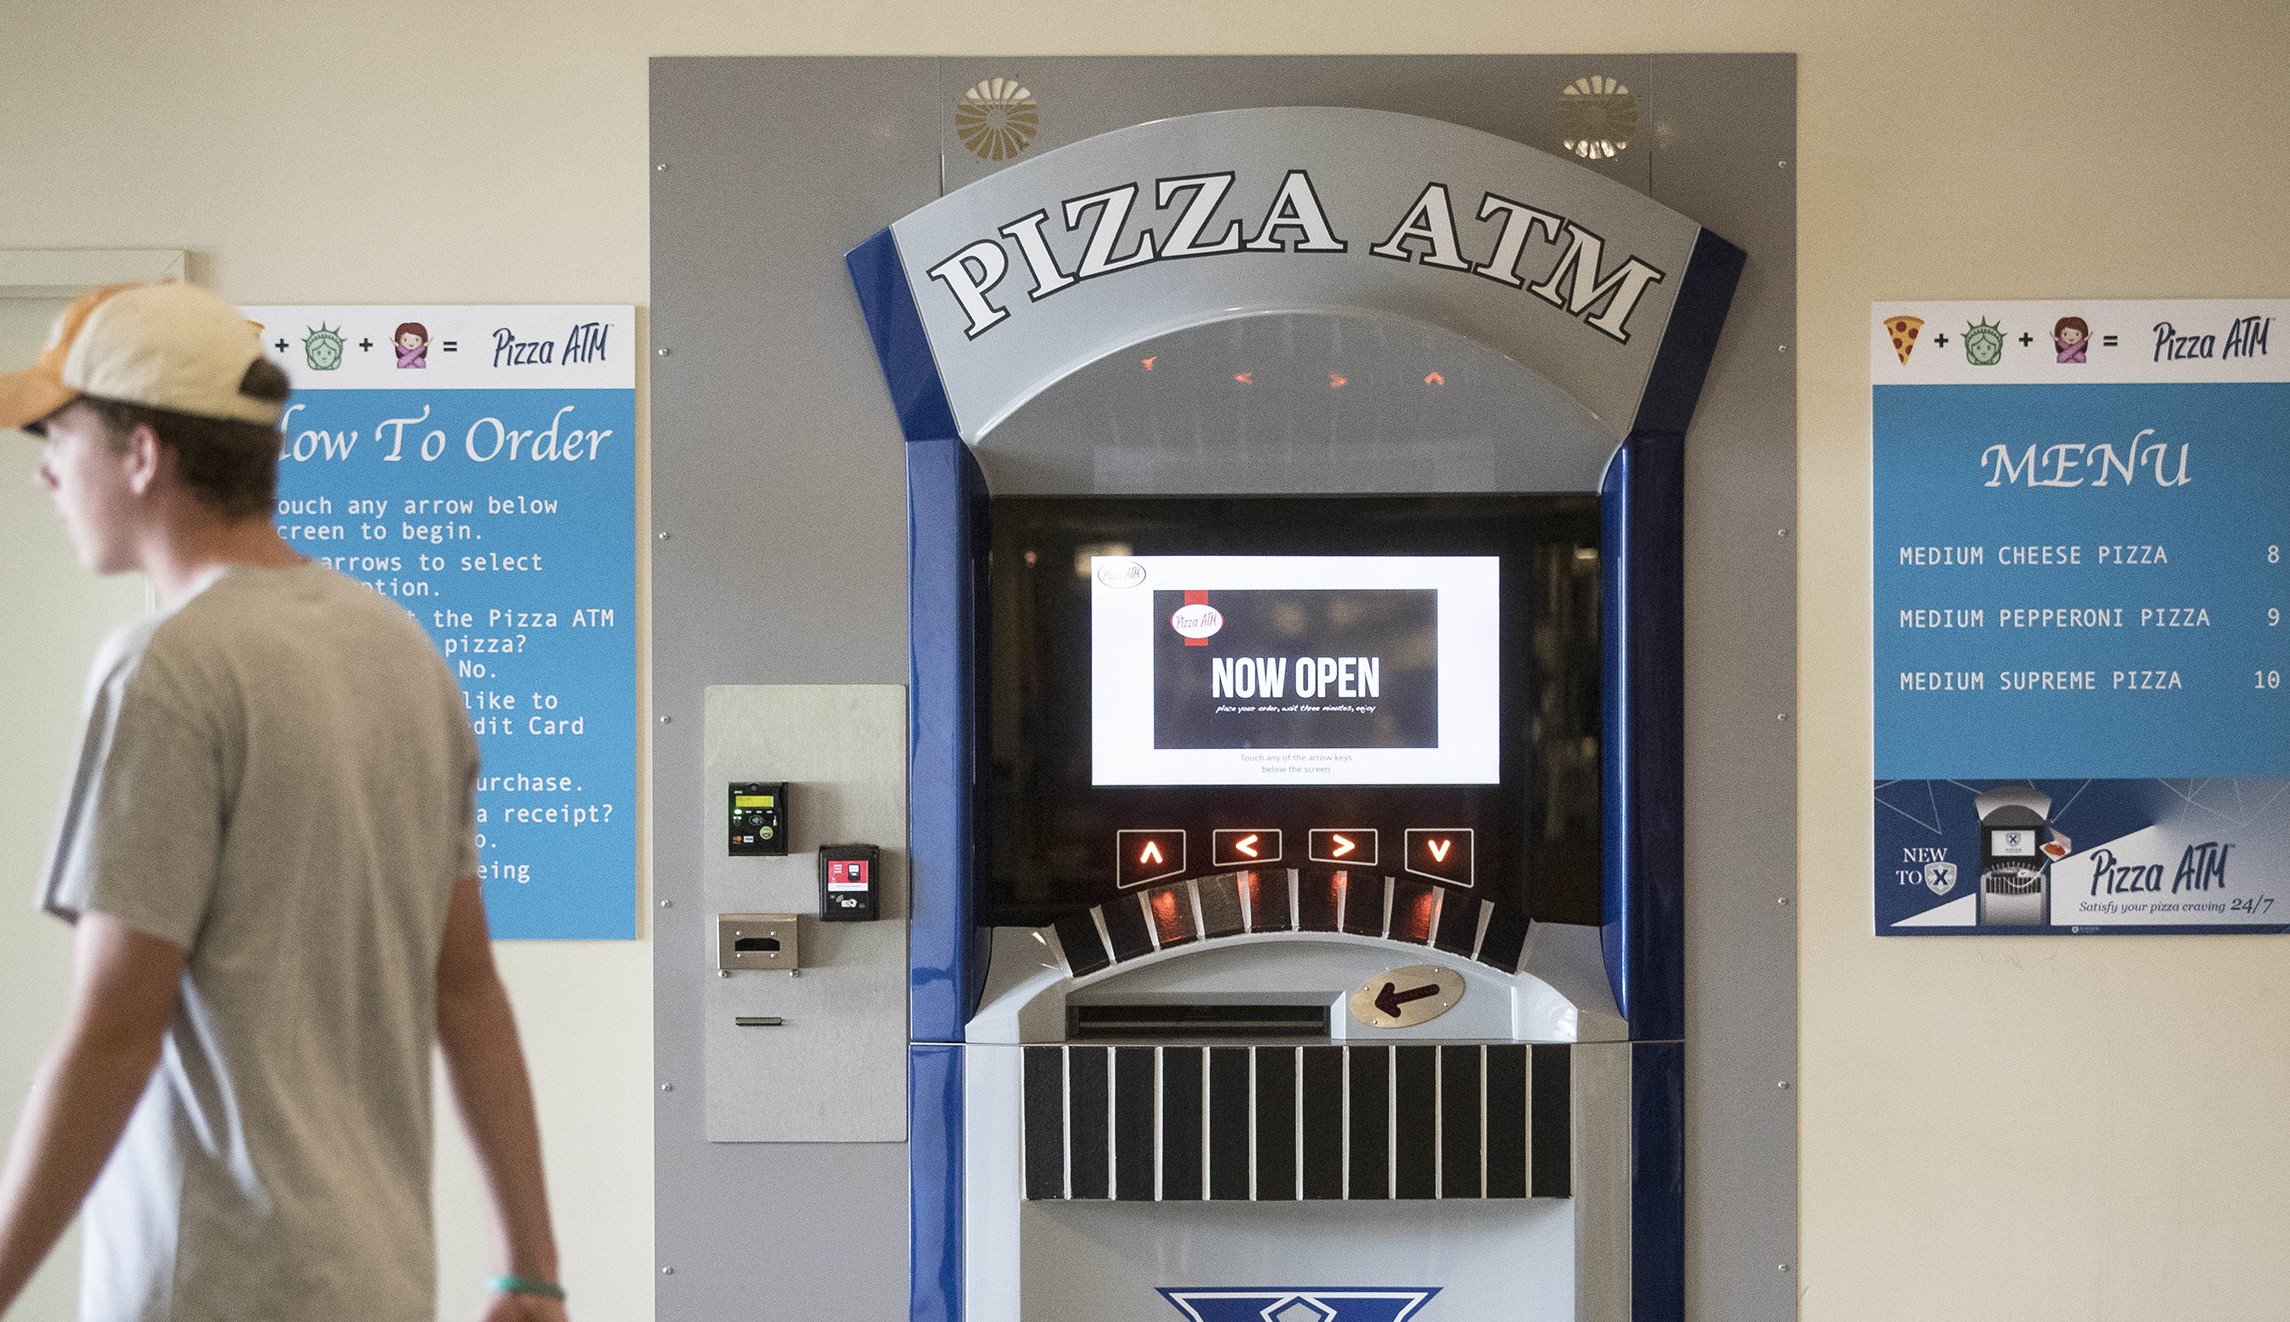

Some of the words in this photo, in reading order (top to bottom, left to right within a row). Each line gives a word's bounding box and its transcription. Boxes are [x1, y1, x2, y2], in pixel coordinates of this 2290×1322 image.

[929, 170, 1348, 341] PIZZA
[1369, 181, 1667, 345] ATM
[492, 327, 555, 368] Pizza
[2153, 321, 2216, 363] Pizza
[375, 404, 446, 462] To
[465, 405, 614, 462] Order
[1980, 428, 2192, 488] MENU
[278, 496, 333, 515] ouch
[348, 499, 389, 519] any
[404, 499, 474, 515] arrow
[488, 495, 558, 515] below
[277, 521, 345, 540] creen
[361, 522, 387, 540] to
[402, 521, 482, 545] begin.
[419, 554, 446, 572] to
[461, 553, 543, 572] select
[1899, 546, 1985, 566] MEDIUM
[1998, 546, 2082, 565] CHEESE
[2099, 545, 2169, 565] PIZZA
[2267, 545, 2281, 564] 8
[361, 577, 441, 597] tion.
[433, 609, 474, 628] the
[489, 608, 558, 628] Pizza
[572, 608, 615, 628] ATM
[1176, 614, 1198, 629] Pizza
[1899, 609, 1985, 629] MEDIUM
[1999, 608, 2124, 628] PEPPERONI
[2140, 607, 2211, 627] PIZZA
[2267, 607, 2280, 627] 9
[444, 634, 527, 657] pizza?
[459, 659, 497, 679] No.
[1212, 657, 1287, 699] NOW
[1295, 656, 1380, 699] OPEN
[1899, 671, 1985, 691] MEDIUM
[1999, 671, 2097, 691] SUPREME
[2112, 670, 2183, 690] PIZZA
[2254, 670, 2281, 690] 10
[463, 691, 516, 710] like
[532, 692, 558, 710] to
[473, 716, 514, 735] dit
[529, 716, 585, 735] Card
[1240, 754, 1265, 762] Touch
[1266, 755, 1281, 764] any
[1282, 754, 1291, 762] of
[1293, 754, 1307, 762] the
[1334, 754, 1353, 764] keys
[1261, 765, 1287, 773] below
[1289, 765, 1302, 773] the
[476, 773, 583, 792] urchase.
[476, 807, 488, 823] a
[504, 804, 614, 828] receipt?
[1903, 847, 1948, 863] NEW
[477, 860, 531, 884] eing
[1895, 870, 1923, 886] TO
[2089, 848, 2165, 897] Pizza
[2078, 900, 2119, 915] Satisfy
[2120, 903, 2149, 915] your
[2149, 902, 2180, 915] pizza
[2181, 902, 2227, 915] craving
[2230, 894, 2276, 914] 24/7
